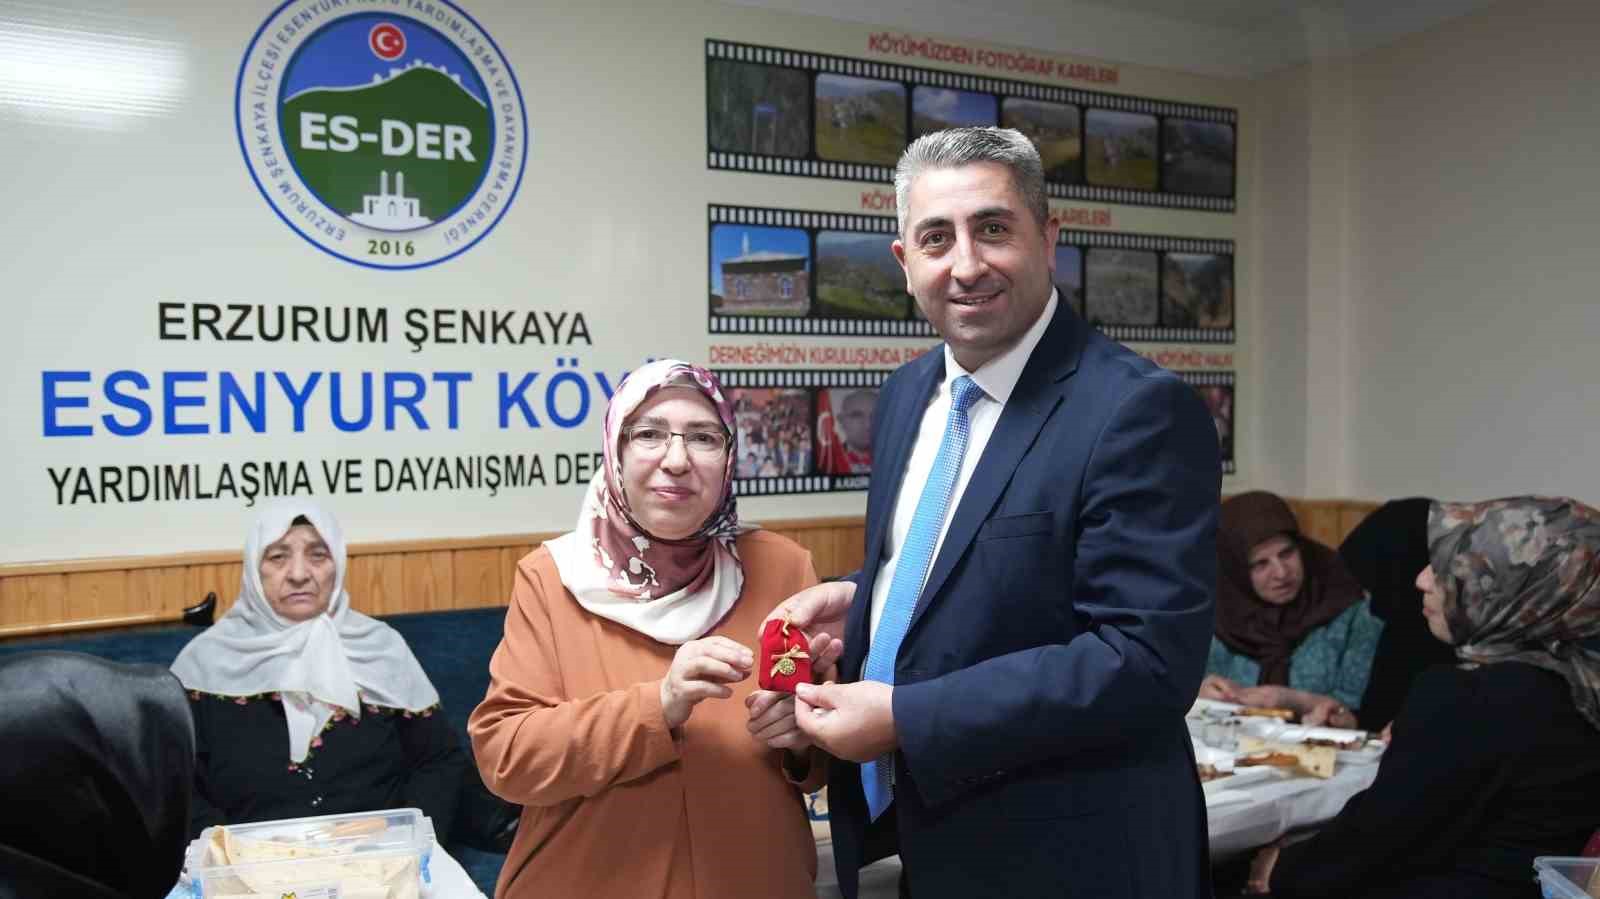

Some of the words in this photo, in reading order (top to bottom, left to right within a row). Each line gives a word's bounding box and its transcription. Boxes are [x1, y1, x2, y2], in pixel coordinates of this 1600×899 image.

[868, 32, 974, 65] KÖYÜMÜZDEN
[976, 49, 1055, 75] FOTOĞRAF
[495, 79, 510, 97] VE
[254, 101, 284, 179] ŞENKAYA
[300, 112, 477, 162] ES-DER
[493, 103, 516, 190] DAYANIŞMA
[279, 181, 346, 241] ERZURUM
[443, 192, 499, 244] DERNEĞİ
[367, 239, 415, 256] 2016
[158, 302, 388, 342] ERZURUM
[404, 307, 592, 353] ŞENKAYA
[42, 370, 472, 437] ESENYURT
[47, 460, 313, 507] YARDIMLAŞMA
[322, 459, 362, 494] VE
[375, 454, 546, 496] DAYANIŞMA
